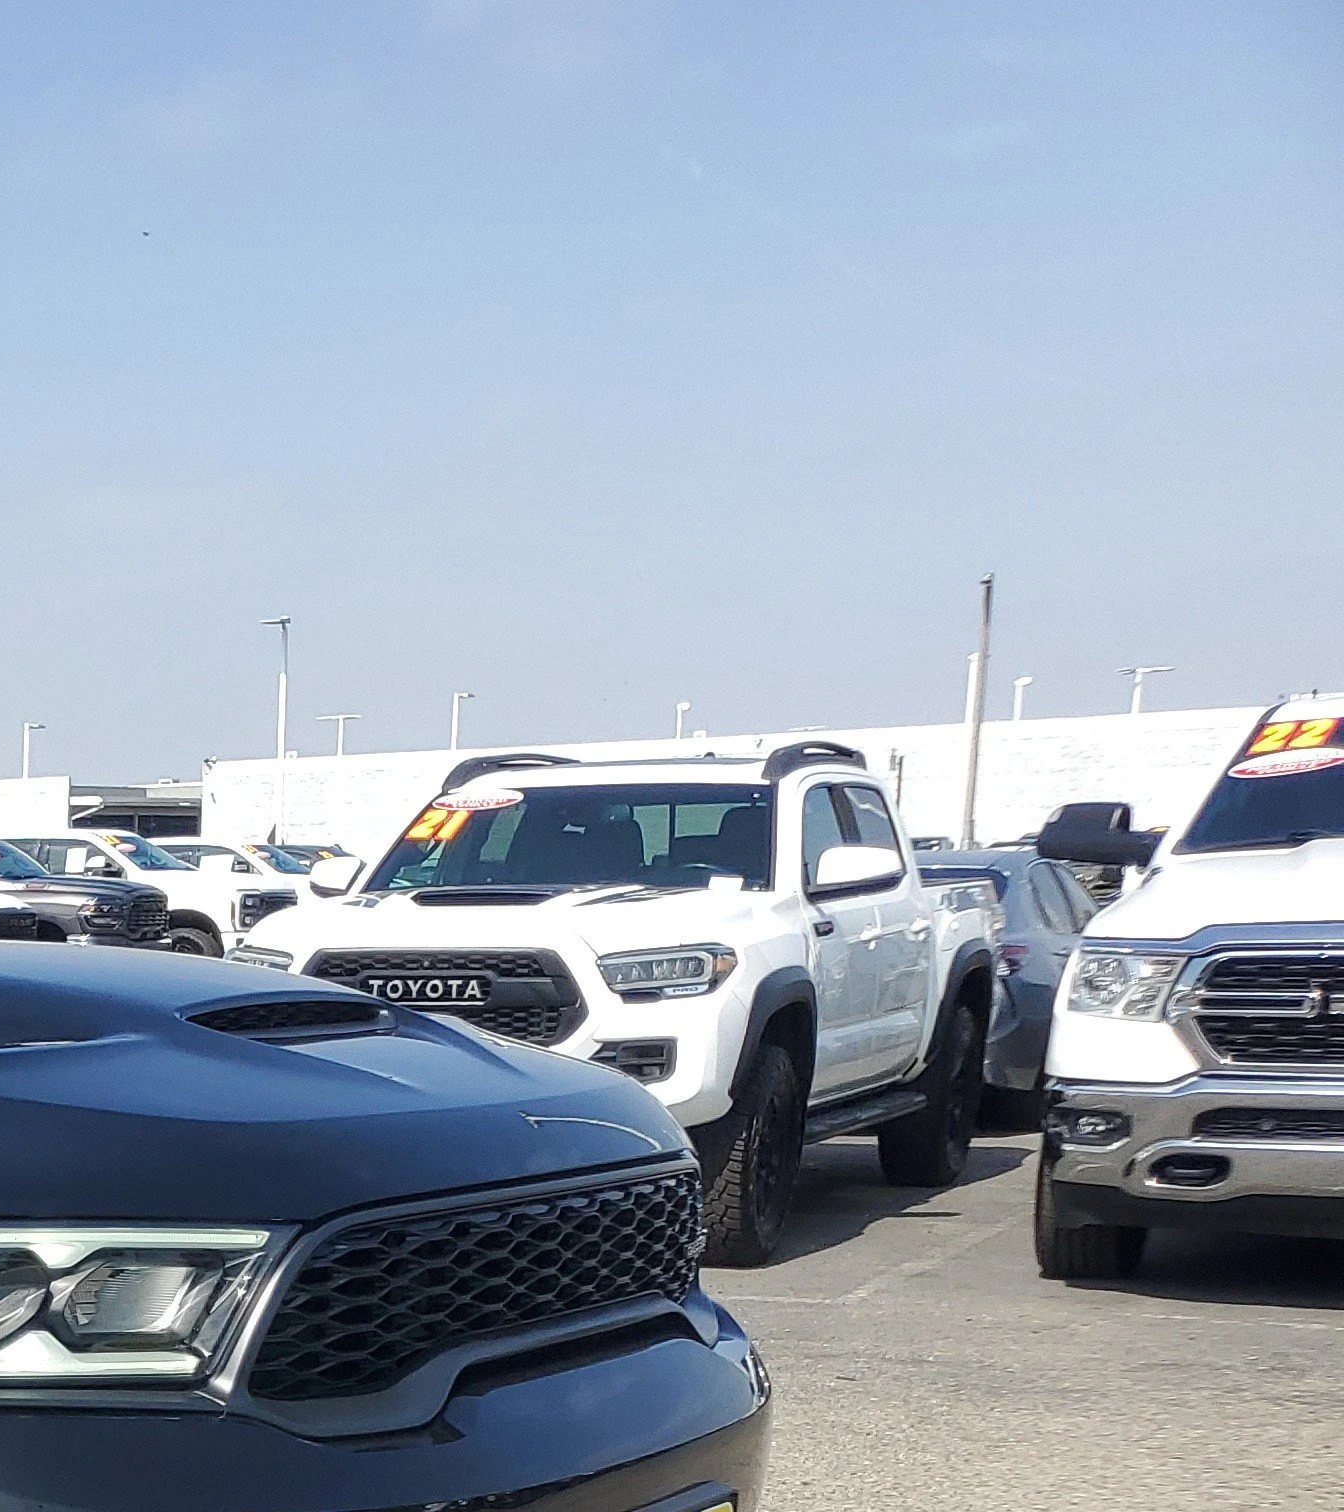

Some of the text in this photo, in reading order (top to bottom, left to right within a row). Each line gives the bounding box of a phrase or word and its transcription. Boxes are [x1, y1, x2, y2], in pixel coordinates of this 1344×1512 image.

[1249, 718, 1334, 753] 22
[408, 808, 469, 839] 21
[368, 979, 482, 999] TOYOTA
